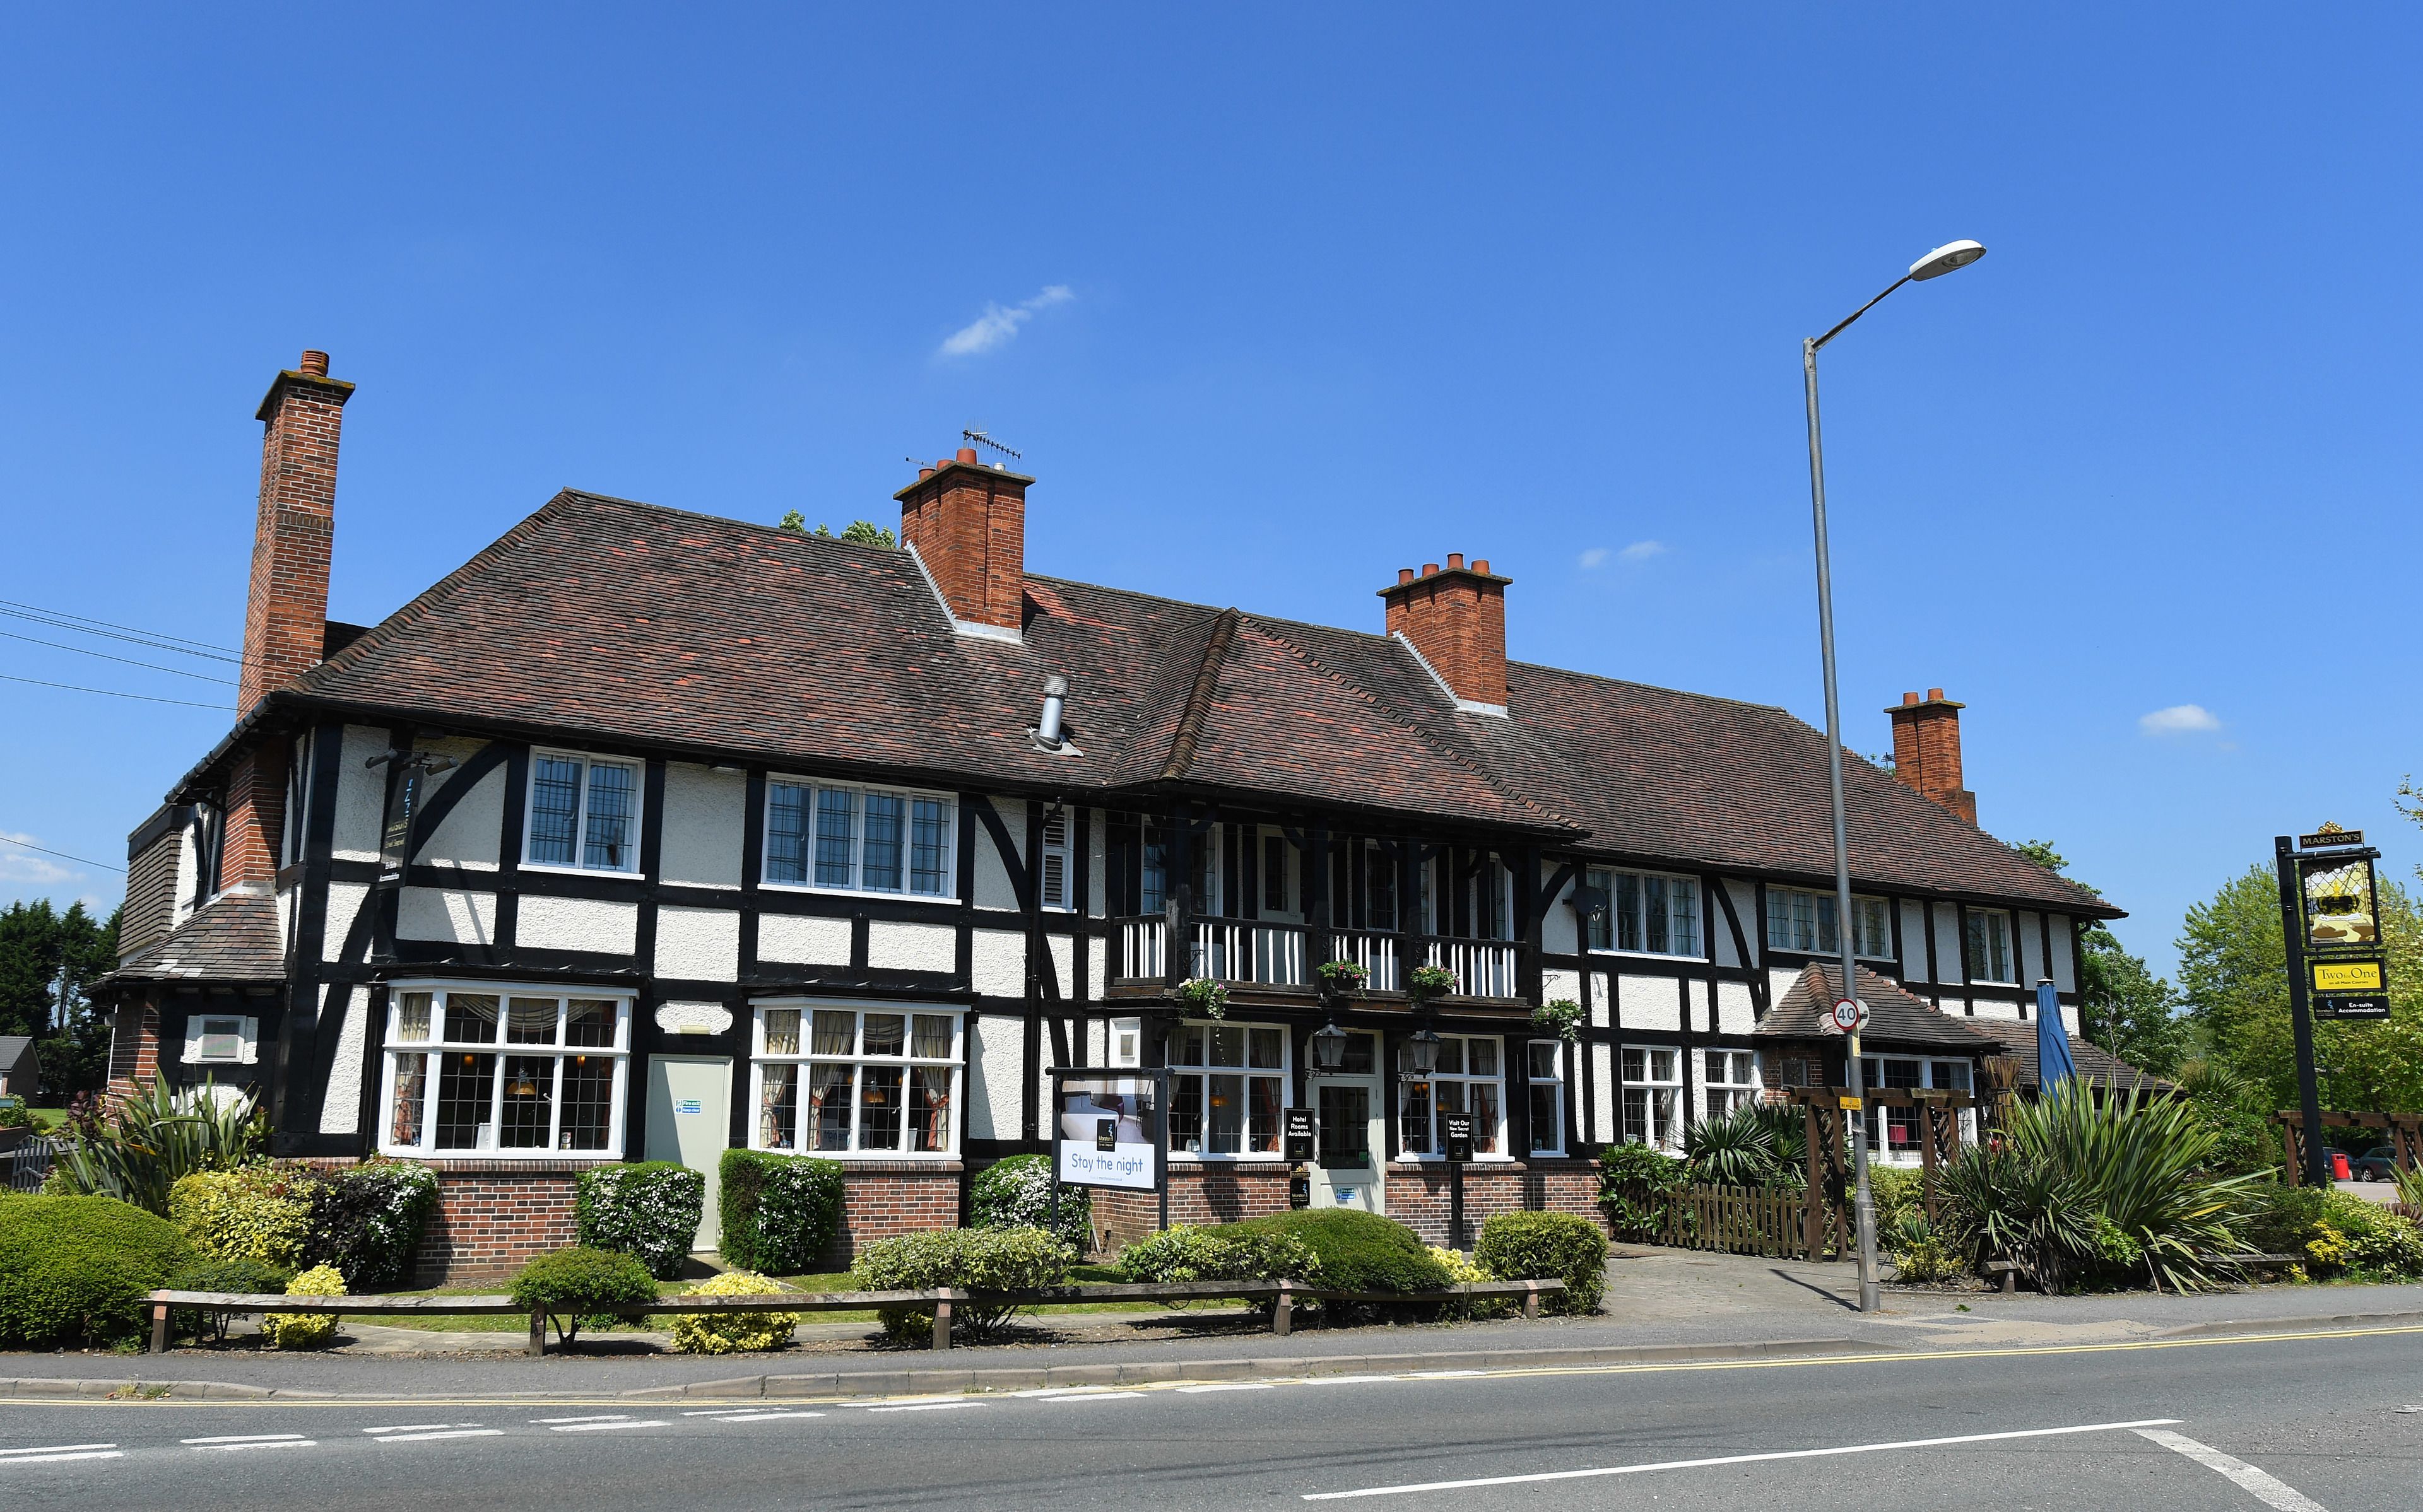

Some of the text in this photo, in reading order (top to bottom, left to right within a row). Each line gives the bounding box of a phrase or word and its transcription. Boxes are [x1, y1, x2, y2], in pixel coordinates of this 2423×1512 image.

[2302, 834, 2360, 845] MARSTON'S
[2318, 969, 2343, 979] Two
[2351, 967, 2377, 978] One
[1837, 1008, 1855, 1020] 40
[1071, 1153, 1143, 1175] Stay the night
